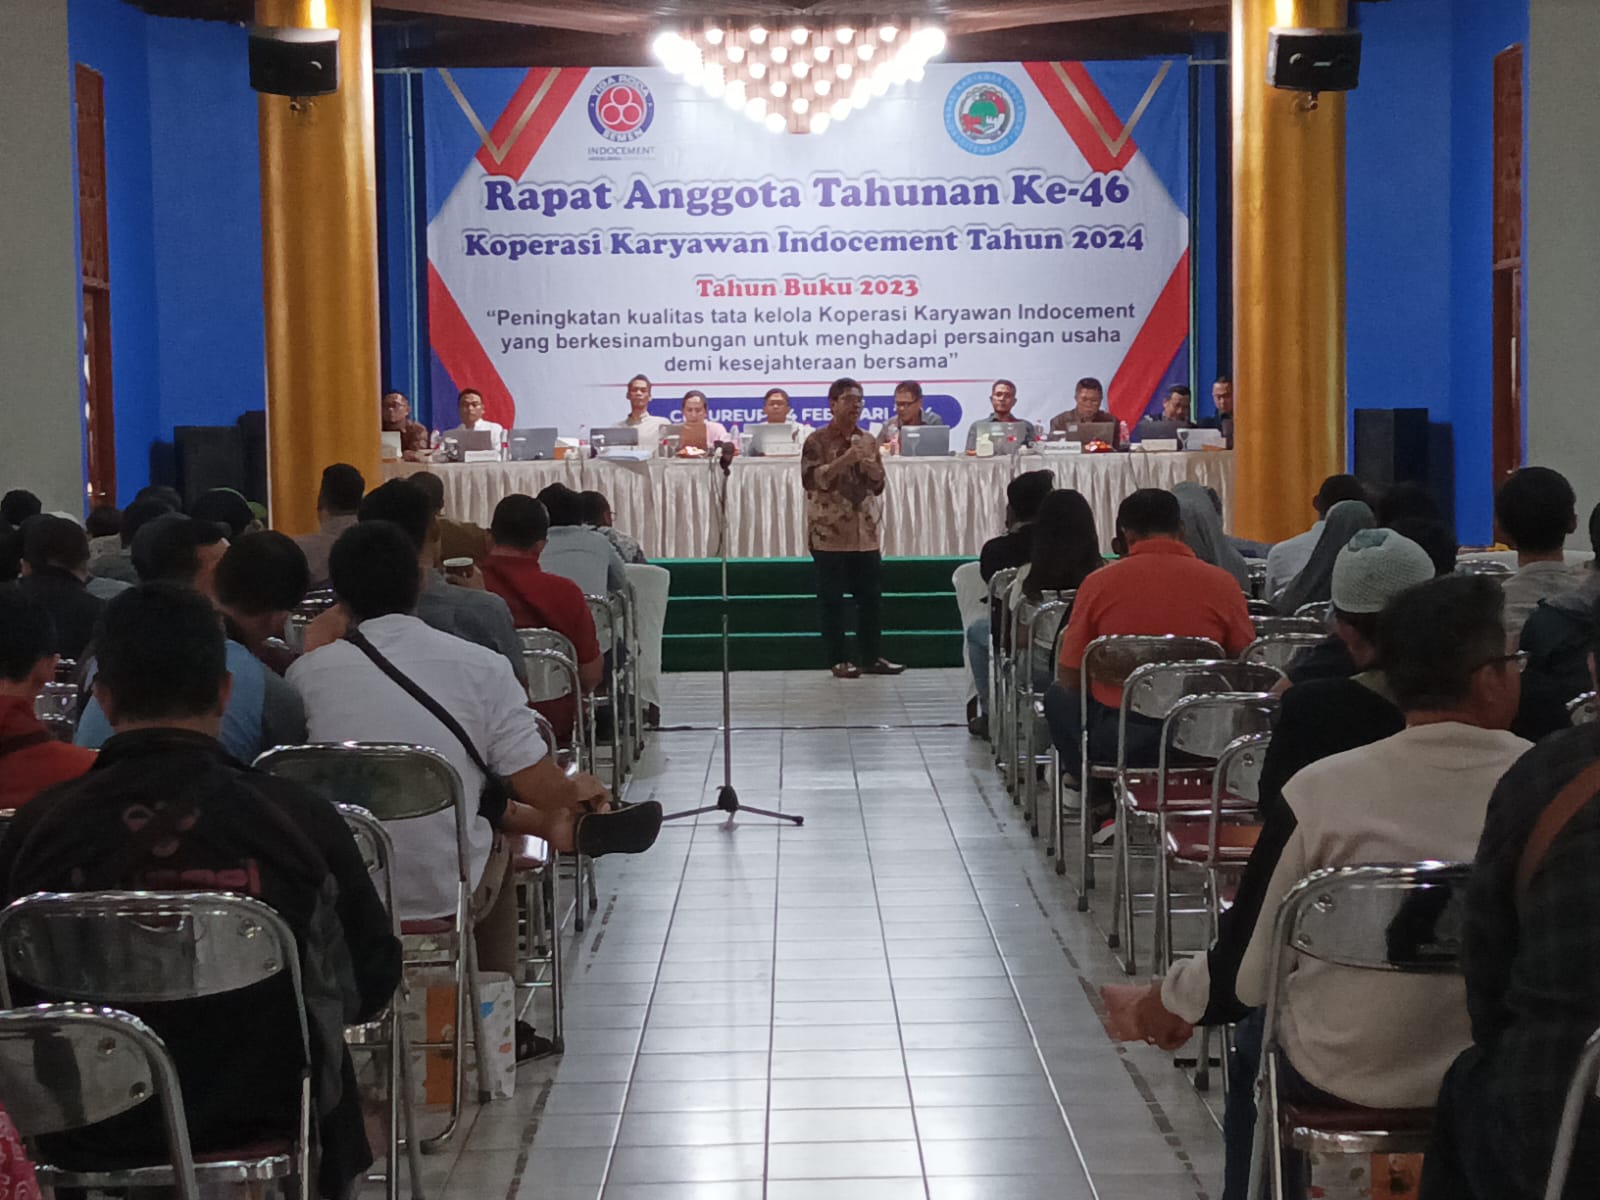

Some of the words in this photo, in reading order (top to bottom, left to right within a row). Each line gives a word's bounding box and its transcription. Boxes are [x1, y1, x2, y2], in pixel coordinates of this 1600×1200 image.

[587, 146, 656, 155] INDOCEMENT
[484, 180, 612, 217] Rapat
[623, 178, 801, 217] Anggota
[813, 177, 1000, 207] Tahunan
[1011, 174, 1130, 207] Ke-46
[465, 233, 602, 260] Koperasi
[609, 232, 769, 259] Karyawan
[778, 227, 959, 253] Indocement
[966, 227, 1064, 251] Tahun
[1072, 229, 1145, 251] 2024
[695, 278, 777, 298] Tahun
[784, 277, 853, 297] Buku
[859, 279, 919, 297] 2023
[627, 308, 705, 325] kualitas
[710, 308, 747, 324] tata
[754, 306, 812, 324] kelola
[819, 305, 907, 326] Koperasi
[914, 304, 1012, 326] Karyawan
[1018, 302, 1136, 320] Indocement
[500, 336, 549, 355] yang
[555, 331, 747, 352] berkesinambungan
[753, 330, 809, 347] untuk
[815, 328, 938, 350] menghadapi
[944, 330, 1055, 349] persaingan
[1061, 325, 1121, 343] usaha
[664, 355, 712, 372] demi
[718, 353, 857, 375] kesejahteraan
[802, 407, 889, 421] FEBARI
